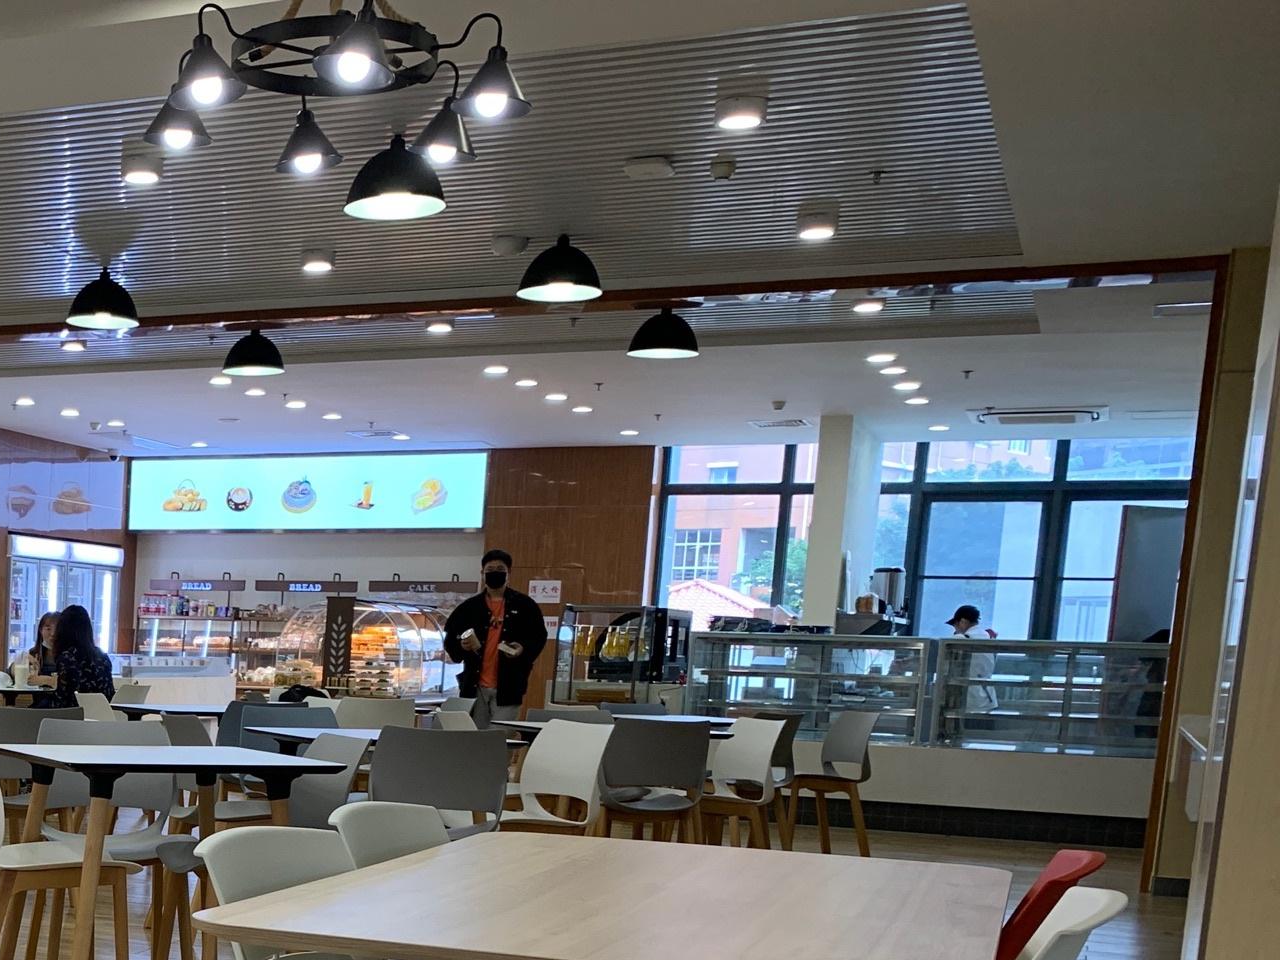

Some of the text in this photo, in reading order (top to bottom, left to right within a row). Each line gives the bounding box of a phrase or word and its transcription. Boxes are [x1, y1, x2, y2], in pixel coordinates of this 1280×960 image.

[181, 582, 213, 592] BREAD
[288, 582, 323, 593] BREAD
[408, 584, 437, 593] CAKE
